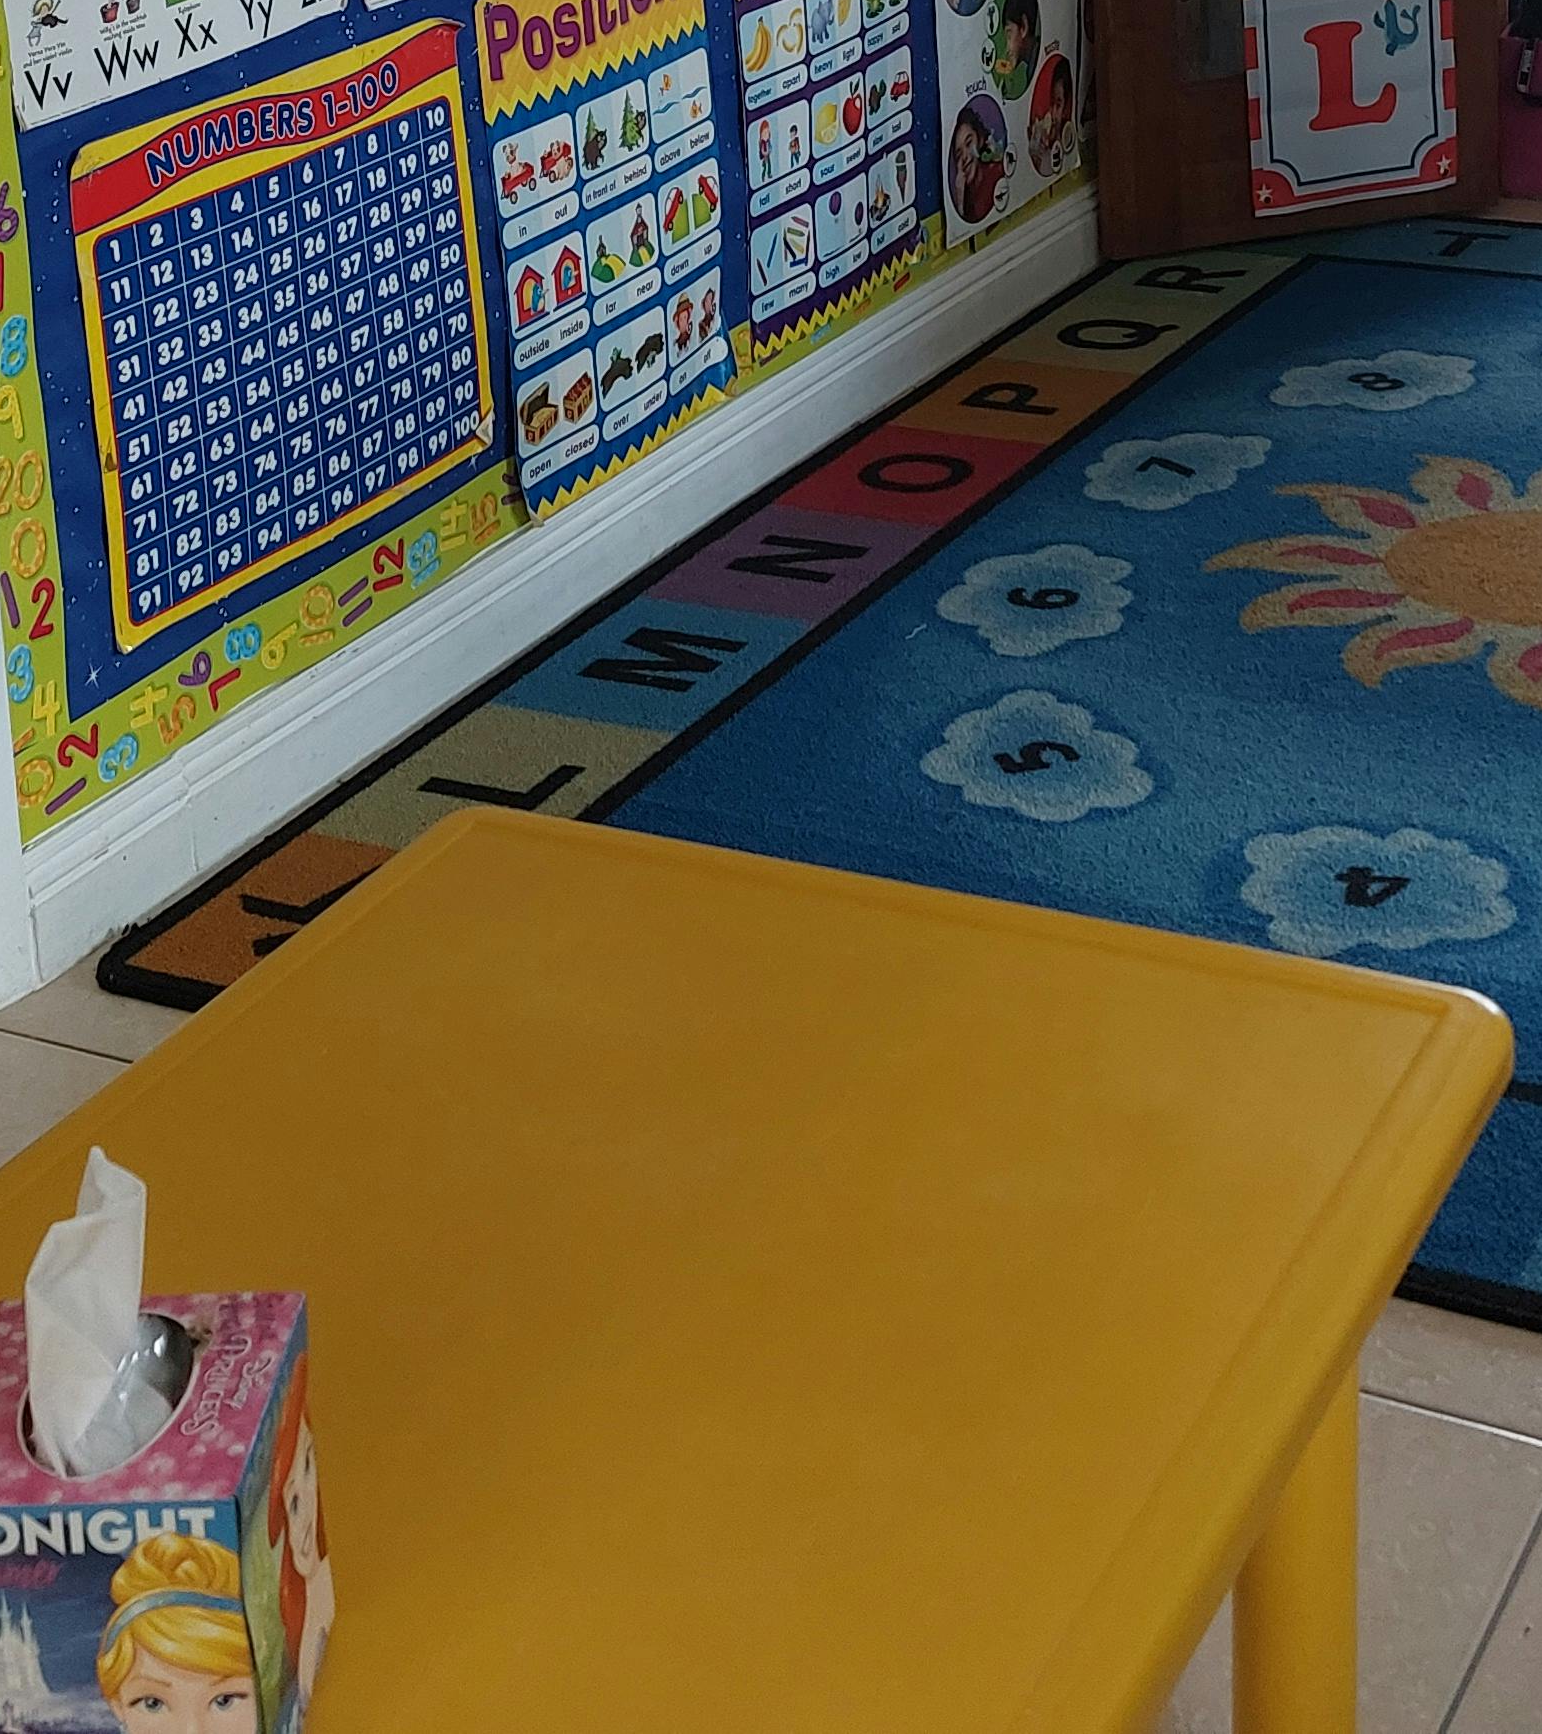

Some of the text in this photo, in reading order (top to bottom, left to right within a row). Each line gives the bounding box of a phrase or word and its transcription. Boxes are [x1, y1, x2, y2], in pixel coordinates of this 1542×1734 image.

[966, 79, 987, 98] touch
[144, 60, 399, 188] NUMBERS 1-100
[659, 131, 710, 167] above below
[585, 189, 592, 203] in
[592, 183, 608, 201] front
[624, 165, 648, 185] behind
[785, 178, 802, 196] short
[519, 320, 584, 362] outside inside
[529, 433, 595, 479] open closed
